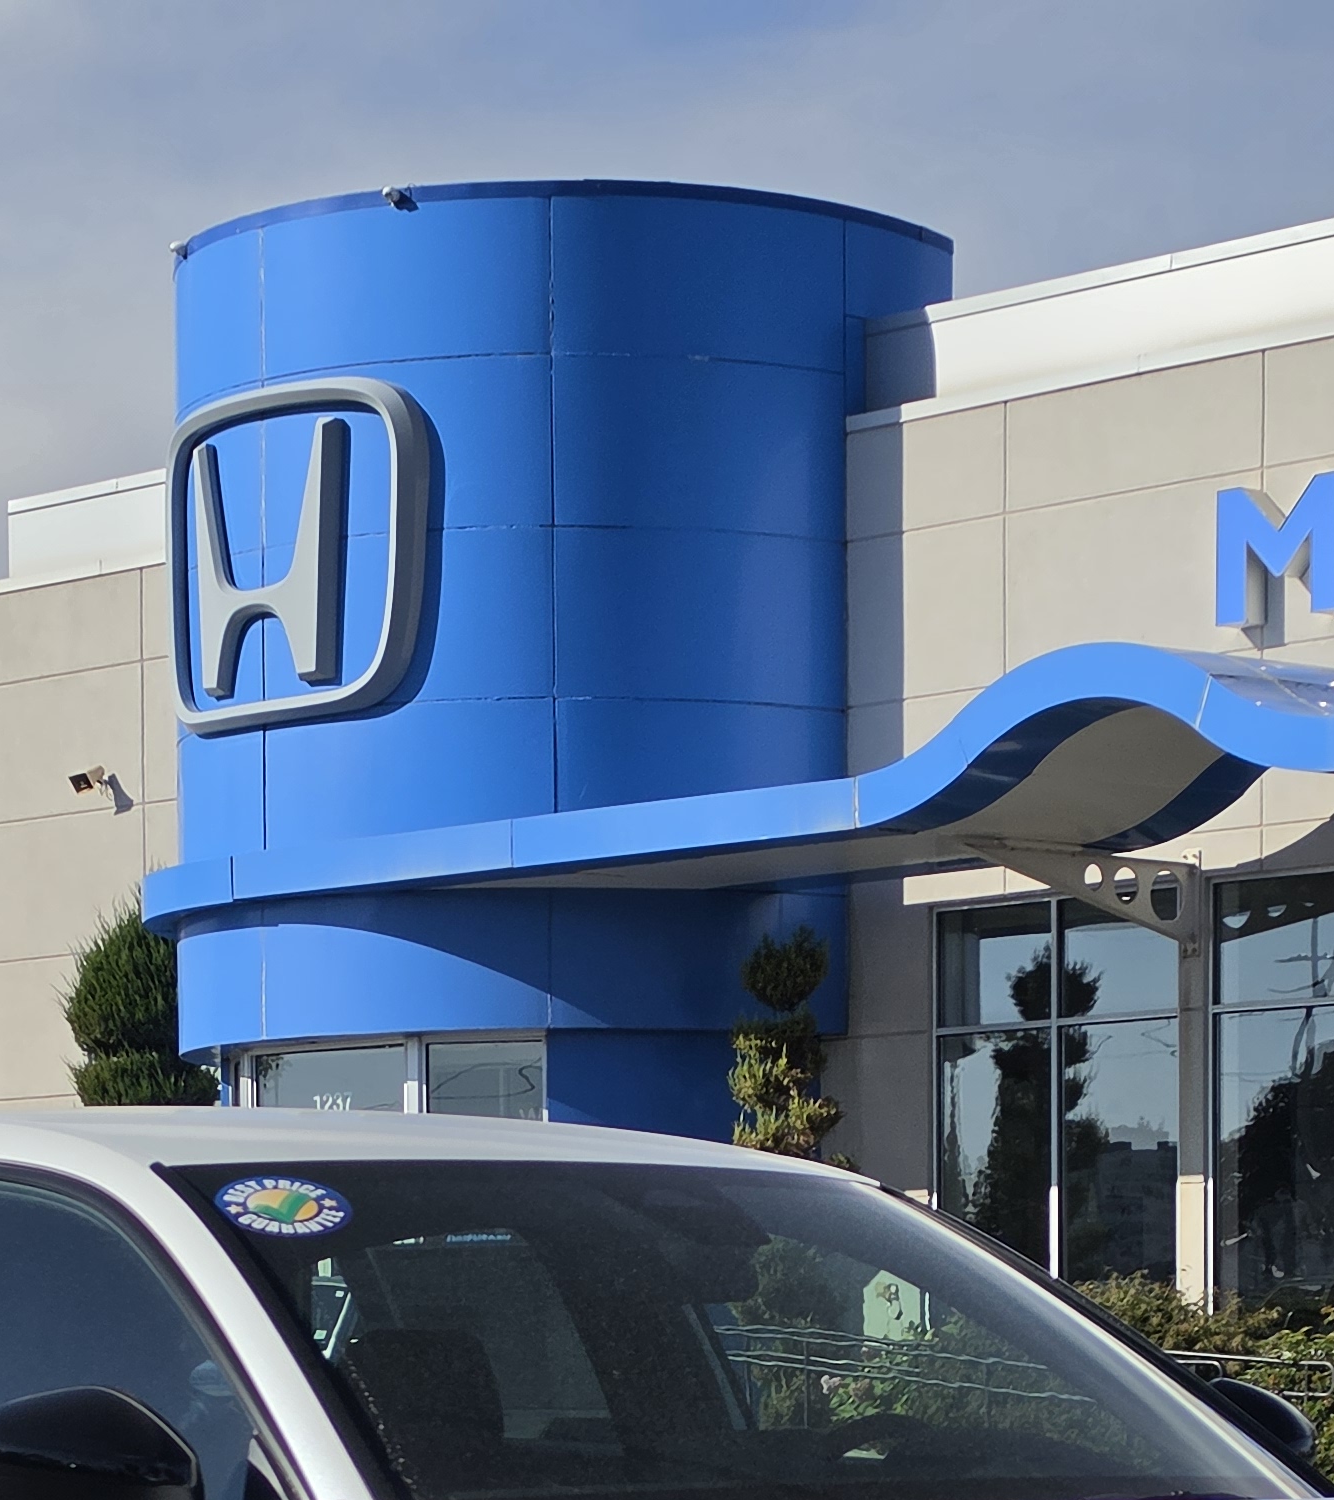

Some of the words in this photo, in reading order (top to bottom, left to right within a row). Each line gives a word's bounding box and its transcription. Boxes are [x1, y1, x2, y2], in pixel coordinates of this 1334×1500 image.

[312, 1091, 353, 1111] 1237
[222, 1180, 263, 1204] BEST
[262, 1178, 327, 1198] PRICE
[237, 1207, 346, 1234] GUARANTEE
